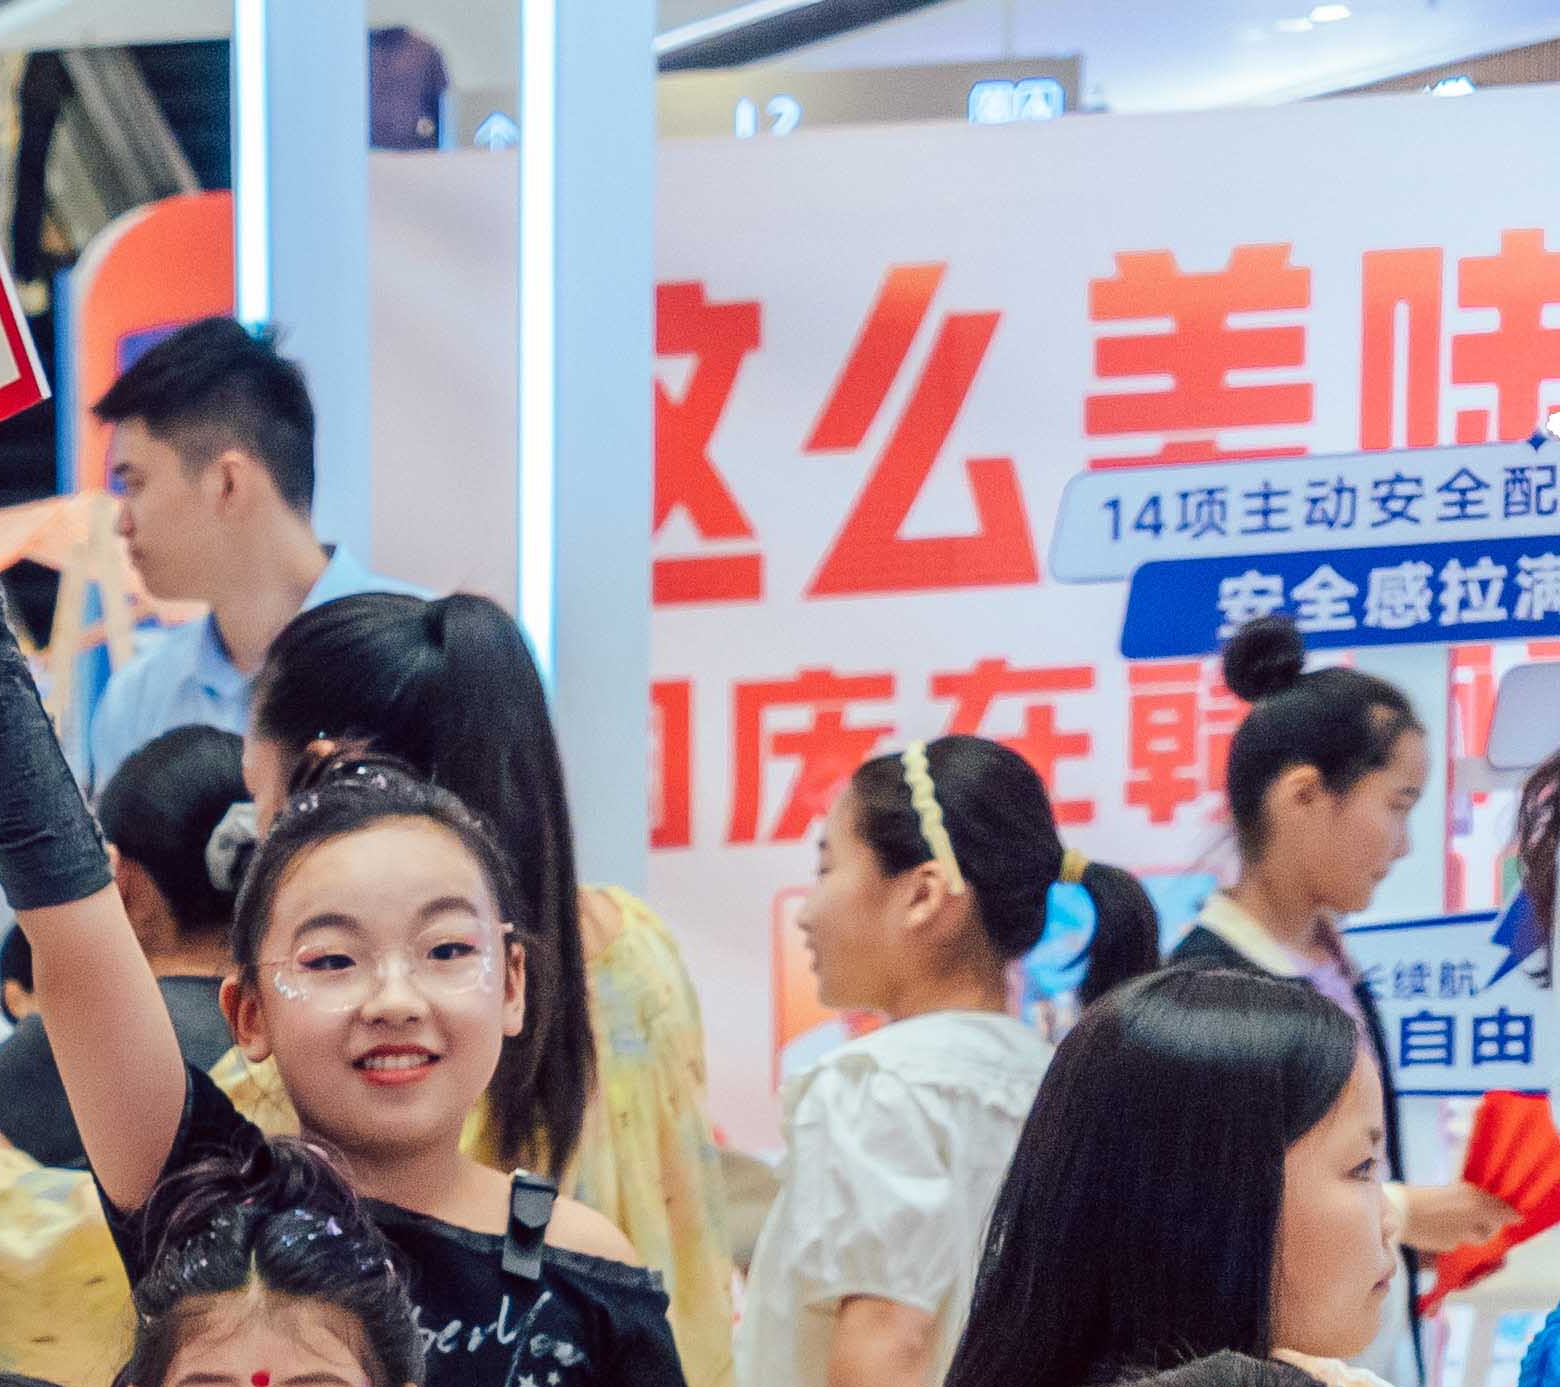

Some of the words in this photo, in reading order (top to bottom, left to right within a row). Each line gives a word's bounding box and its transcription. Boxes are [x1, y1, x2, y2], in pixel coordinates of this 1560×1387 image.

[1102, 464, 1560, 543] 14项主动安全配
[1217, 551, 1560, 639] 安全感拉满
[1399, 1004, 1534, 1067] 自由
